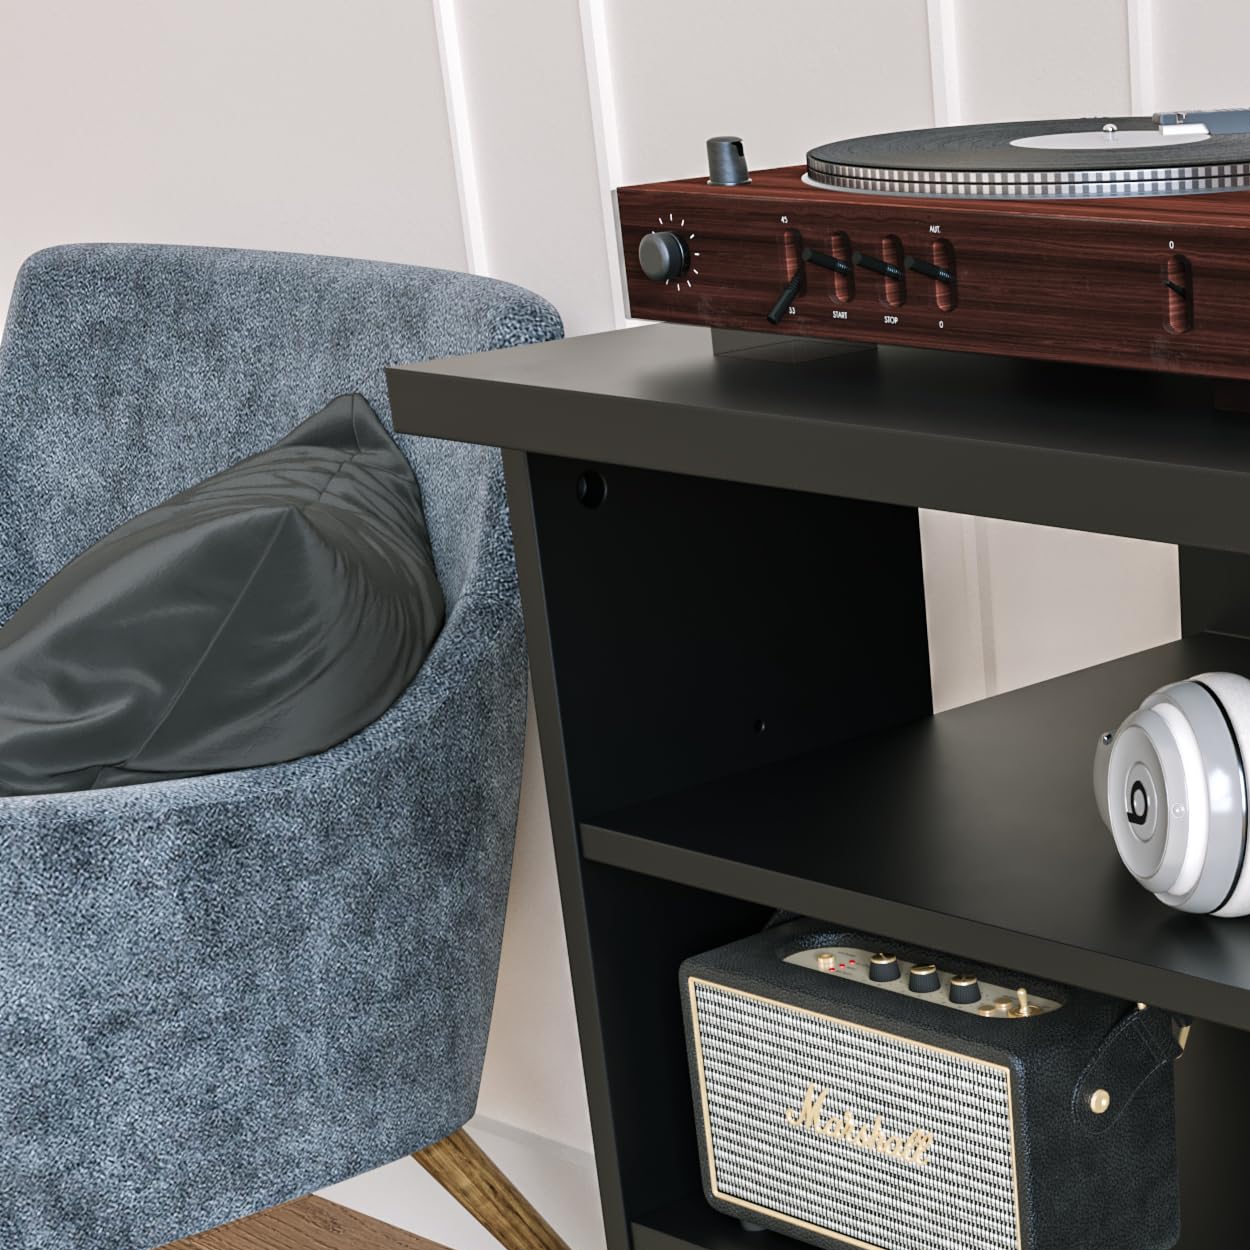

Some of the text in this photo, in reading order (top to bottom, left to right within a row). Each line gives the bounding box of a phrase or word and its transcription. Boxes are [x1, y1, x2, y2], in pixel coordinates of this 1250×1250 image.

[832, 311, 848, 319] START
[884, 316, 899, 325] STOP
[785, 1082, 934, 1166] Marshall
